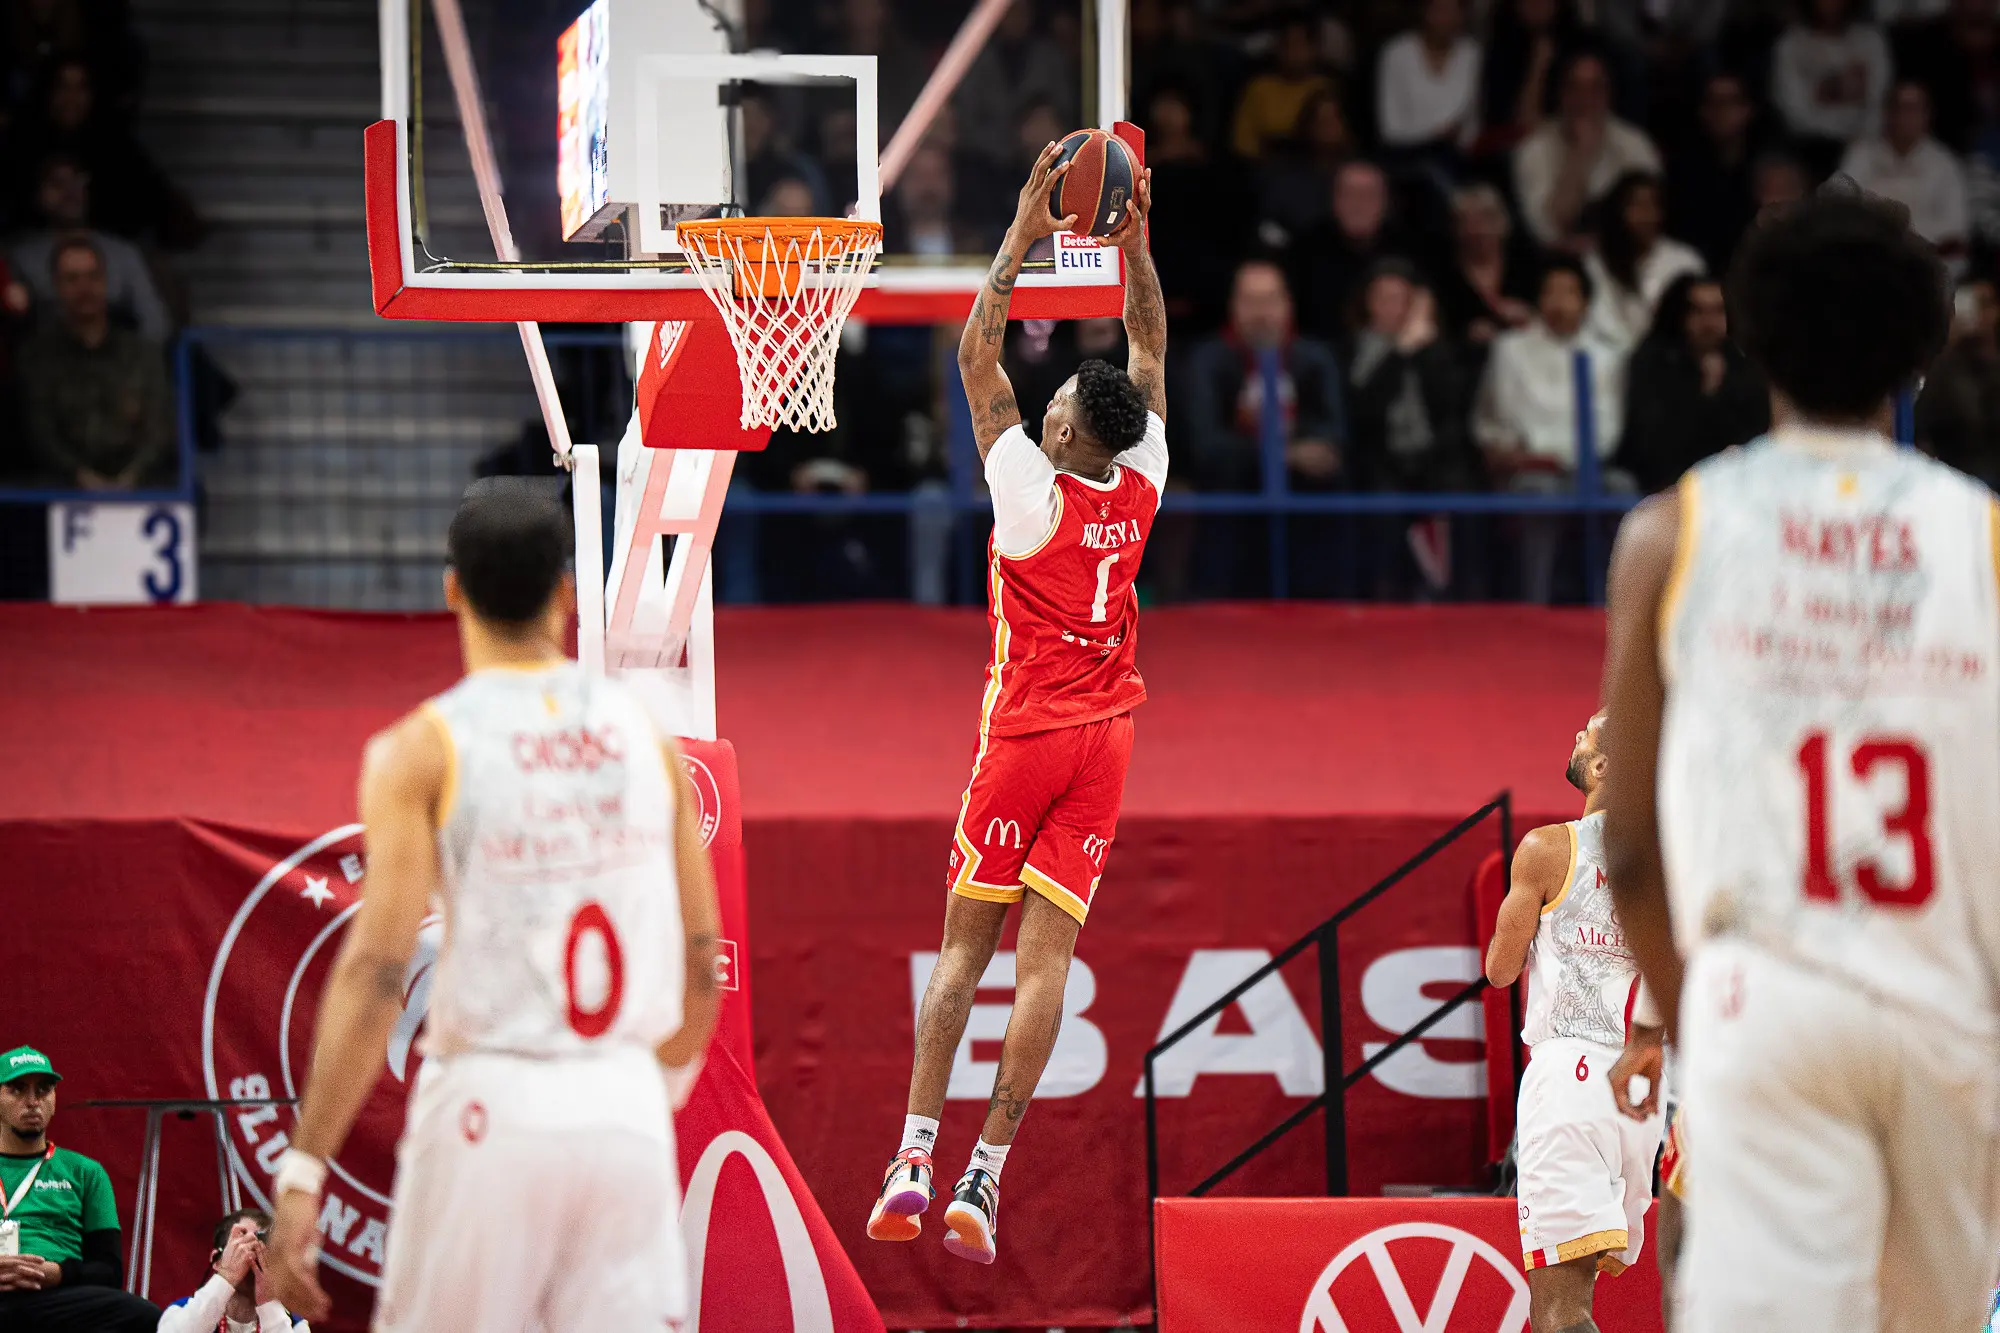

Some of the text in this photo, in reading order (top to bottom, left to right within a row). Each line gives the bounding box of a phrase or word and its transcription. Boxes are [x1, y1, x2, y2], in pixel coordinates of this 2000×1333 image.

[1061, 250, 1102, 268] ÉLITE
[1062, 235, 1098, 247] Betclic
[144, 507, 181, 602] 3
[1090, 552, 1120, 623] 1
[1795, 727, 1937, 912] 13
[563, 898, 625, 1040] 0
[1575, 1055, 1590, 1082] 6
